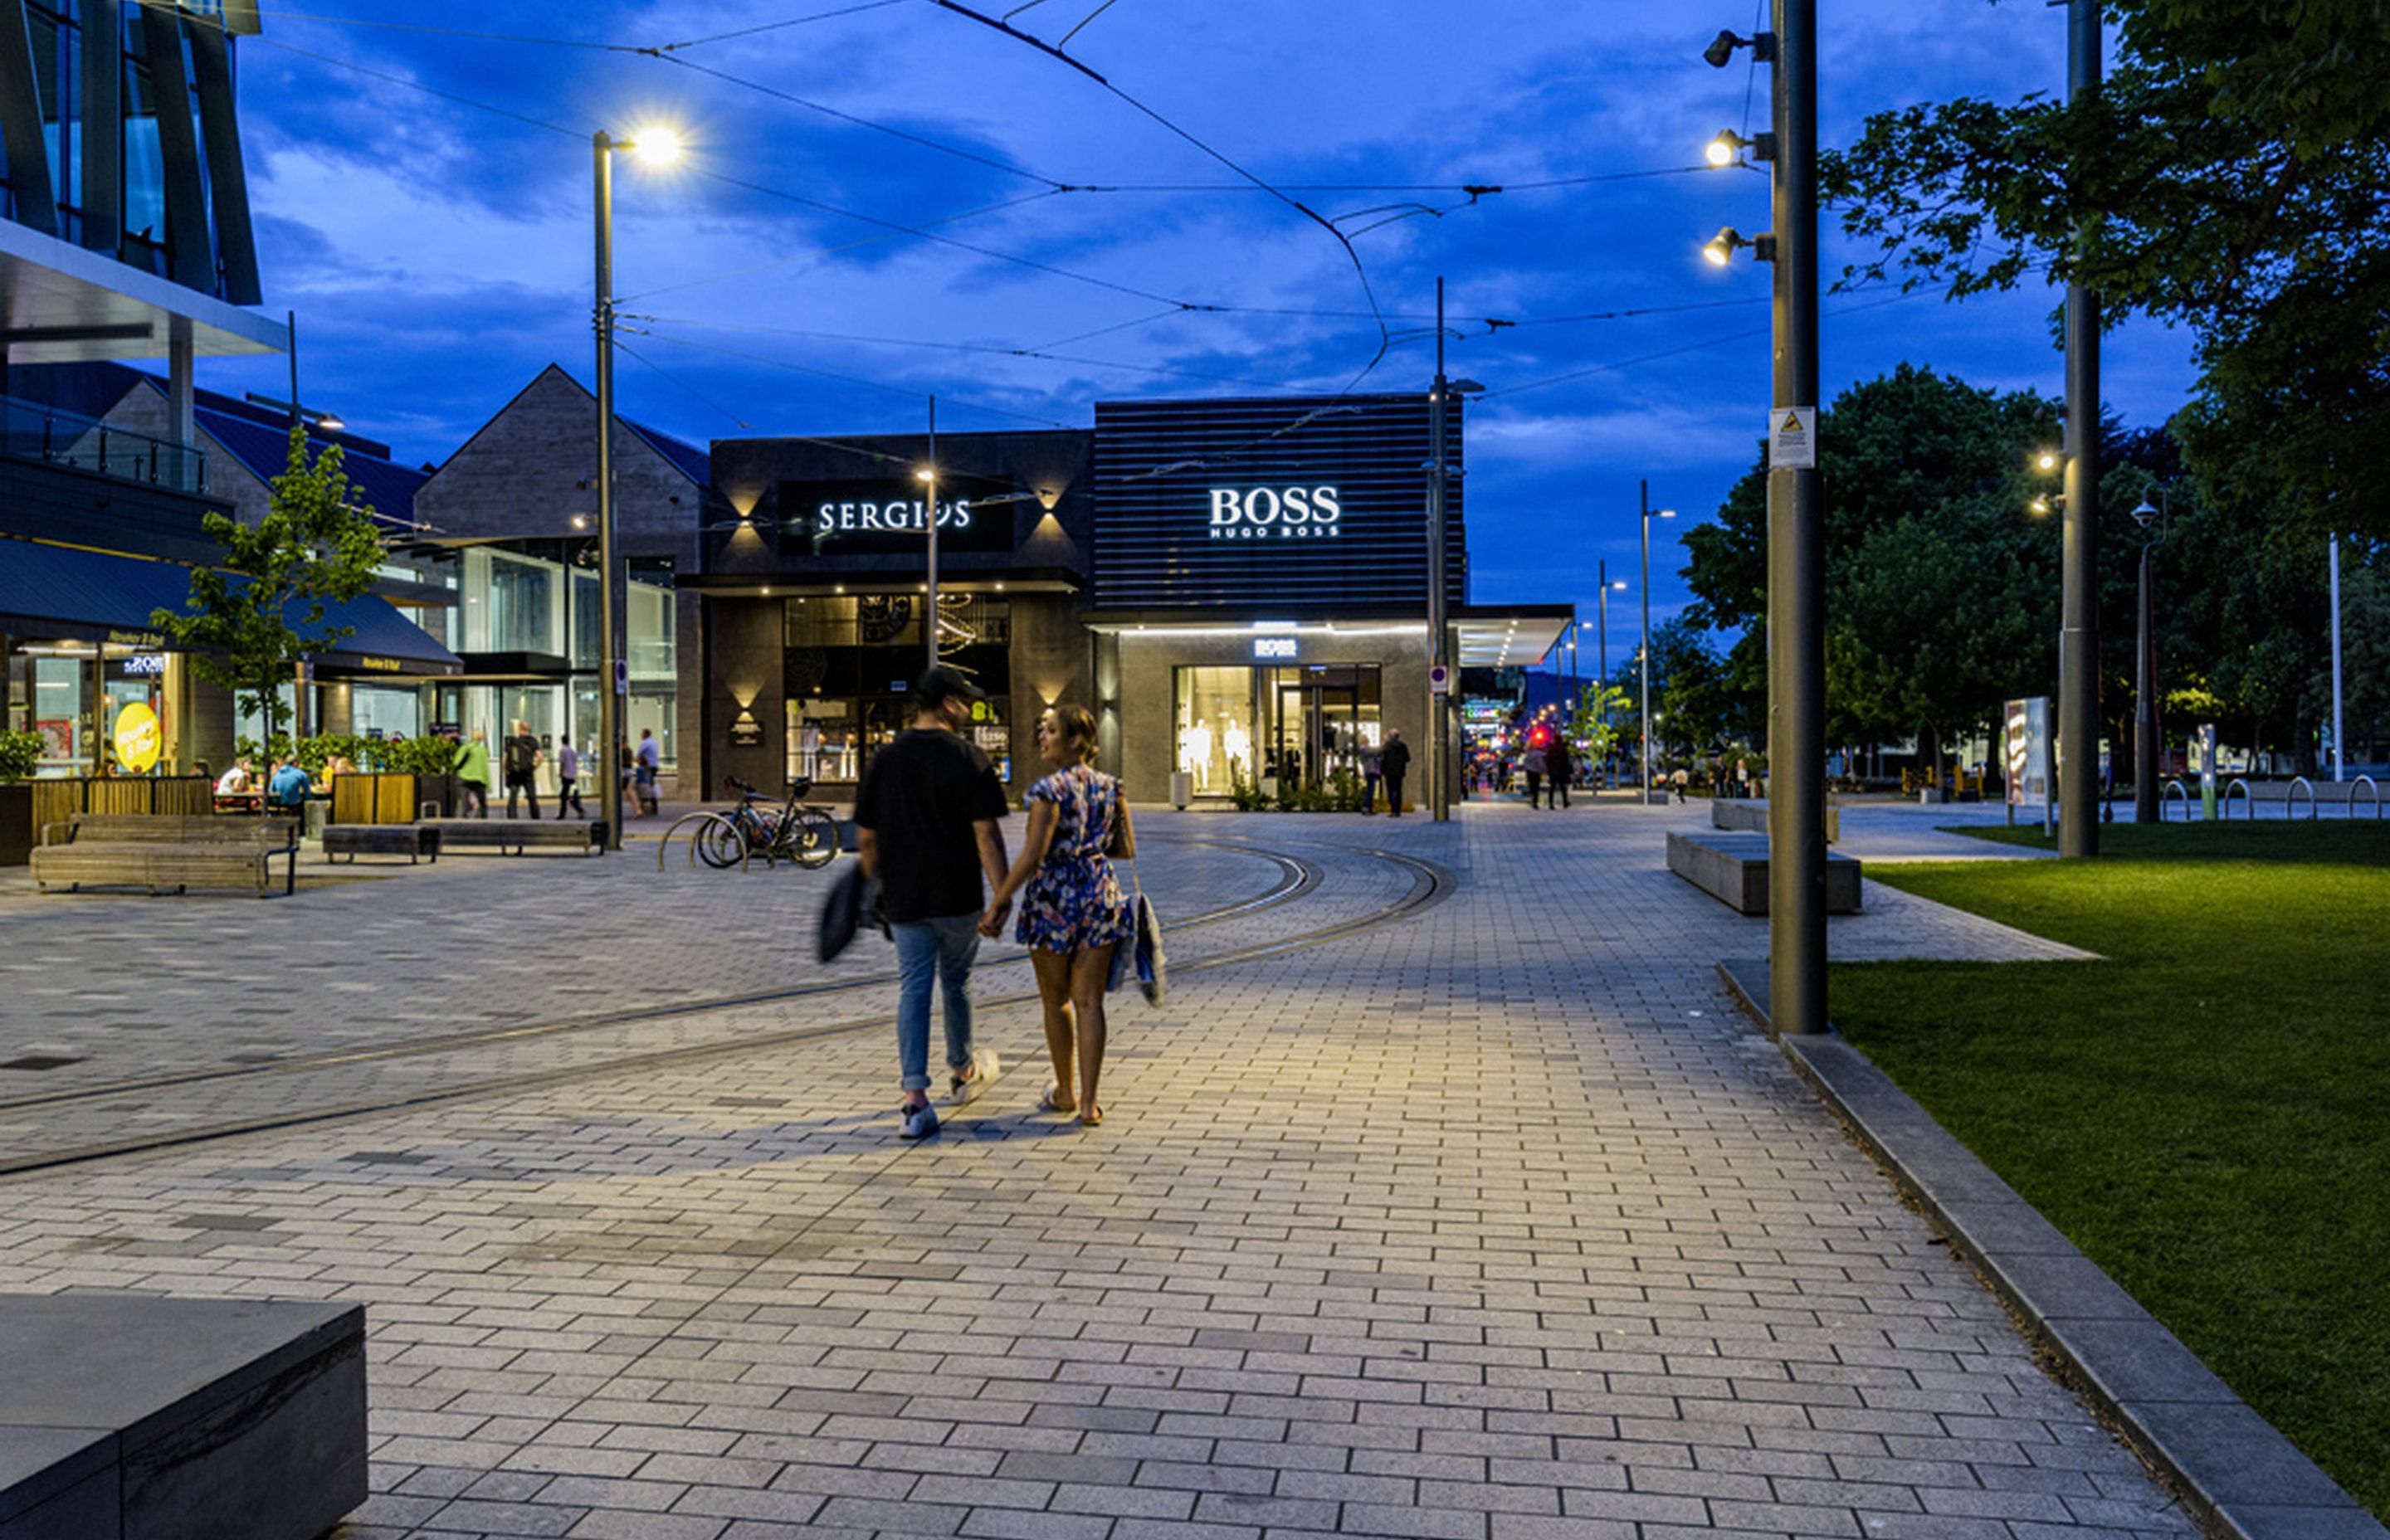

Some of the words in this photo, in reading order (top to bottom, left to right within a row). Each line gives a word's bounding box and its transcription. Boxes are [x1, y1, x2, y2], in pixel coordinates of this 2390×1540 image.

[1209, 486, 1340, 525] BOSS
[1210, 527, 1267, 539] HUGO
[1281, 525, 1339, 538] BOSS
